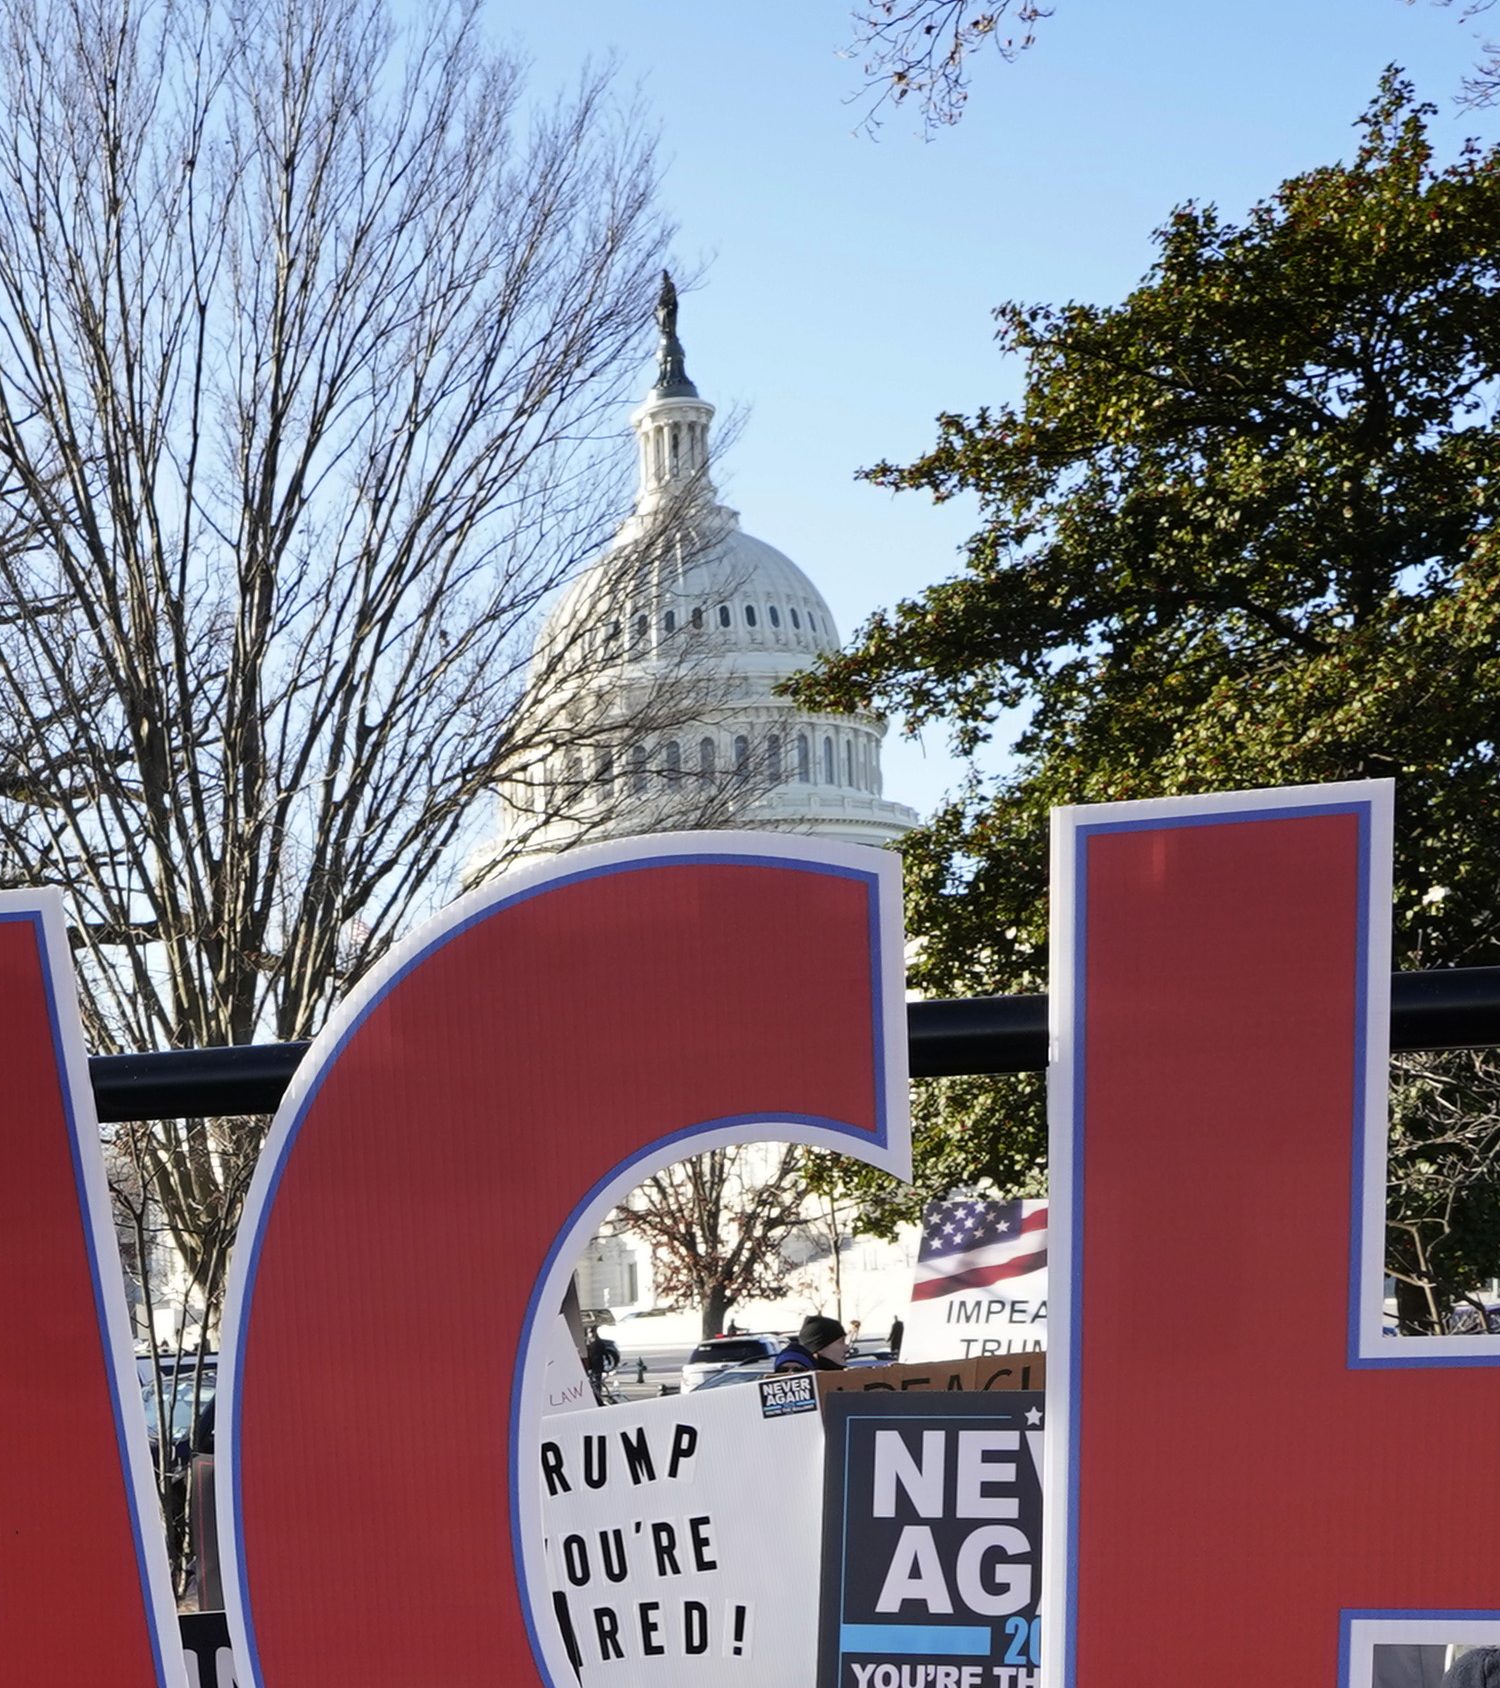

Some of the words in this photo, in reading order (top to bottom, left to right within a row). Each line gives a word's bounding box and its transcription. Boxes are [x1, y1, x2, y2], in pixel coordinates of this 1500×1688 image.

[763, 1378, 811, 1396] NEVER
[766, 1390, 810, 1406] AGAIN
[544, 1515, 718, 1587] OU'RE
